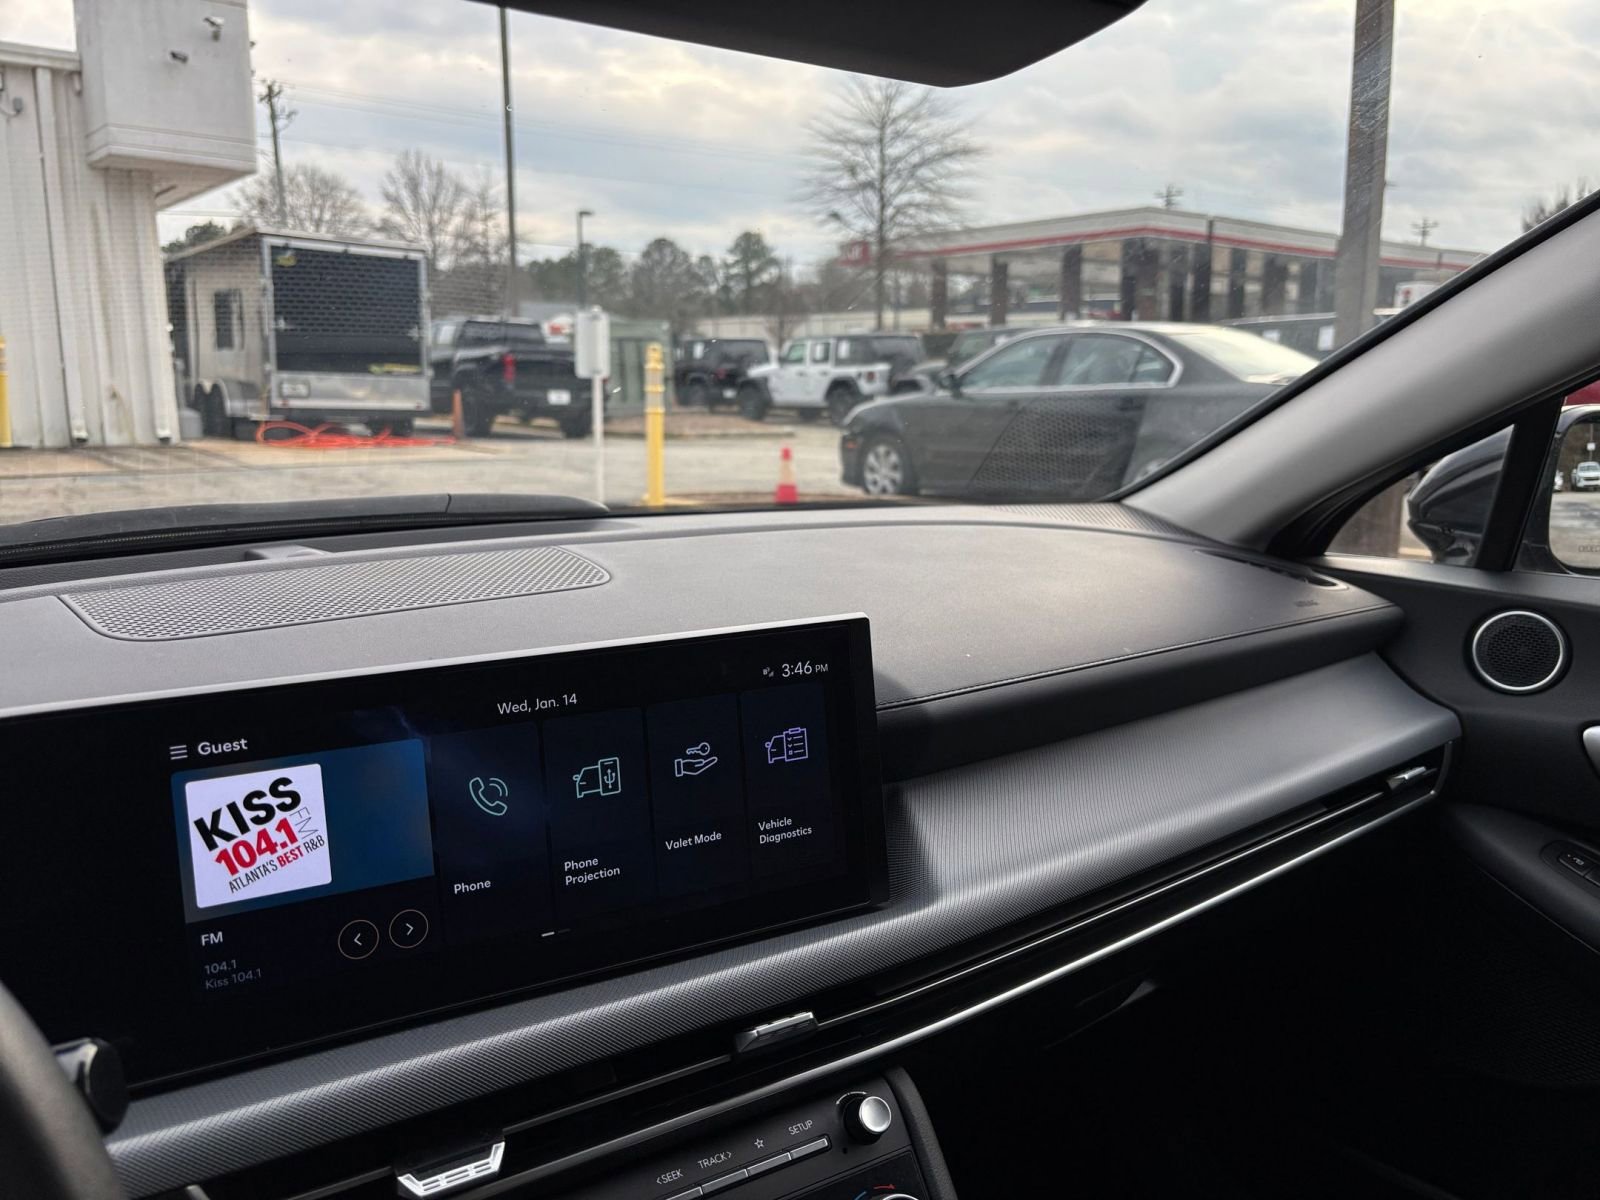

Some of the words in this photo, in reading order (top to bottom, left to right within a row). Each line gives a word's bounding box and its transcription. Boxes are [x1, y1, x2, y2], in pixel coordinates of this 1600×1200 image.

[781, 662, 813, 678] 3:46
[815, 663, 829, 673] PM
[497, 699, 532, 715] Wed,
[535, 694, 559, 711] Jan.
[562, 693, 577, 706] 14
[197, 738, 248, 757] Guest
[193, 776, 302, 852] KISS
[288, 805, 319, 840] FM
[758, 816, 793, 832] Vehicle
[665, 836, 693, 851] Valet
[694, 830, 722, 846] Mode
[758, 825, 812, 845] Diagnostics
[215, 817, 299, 876] 104.1
[228, 860, 279, 894] ATLANTA'S
[276, 848, 305, 868] BEST
[303, 834, 326, 855] R&B
[563, 856, 599, 871] Phone
[565, 865, 621, 886] Projection
[453, 878, 492, 895] Phone
[200, 931, 224, 946] FM
[204, 959, 237, 975] 104.1
[204, 975, 229, 990] Kiss
[231, 968, 262, 984] 104.1
[788, 1120, 813, 1136] SETUP
